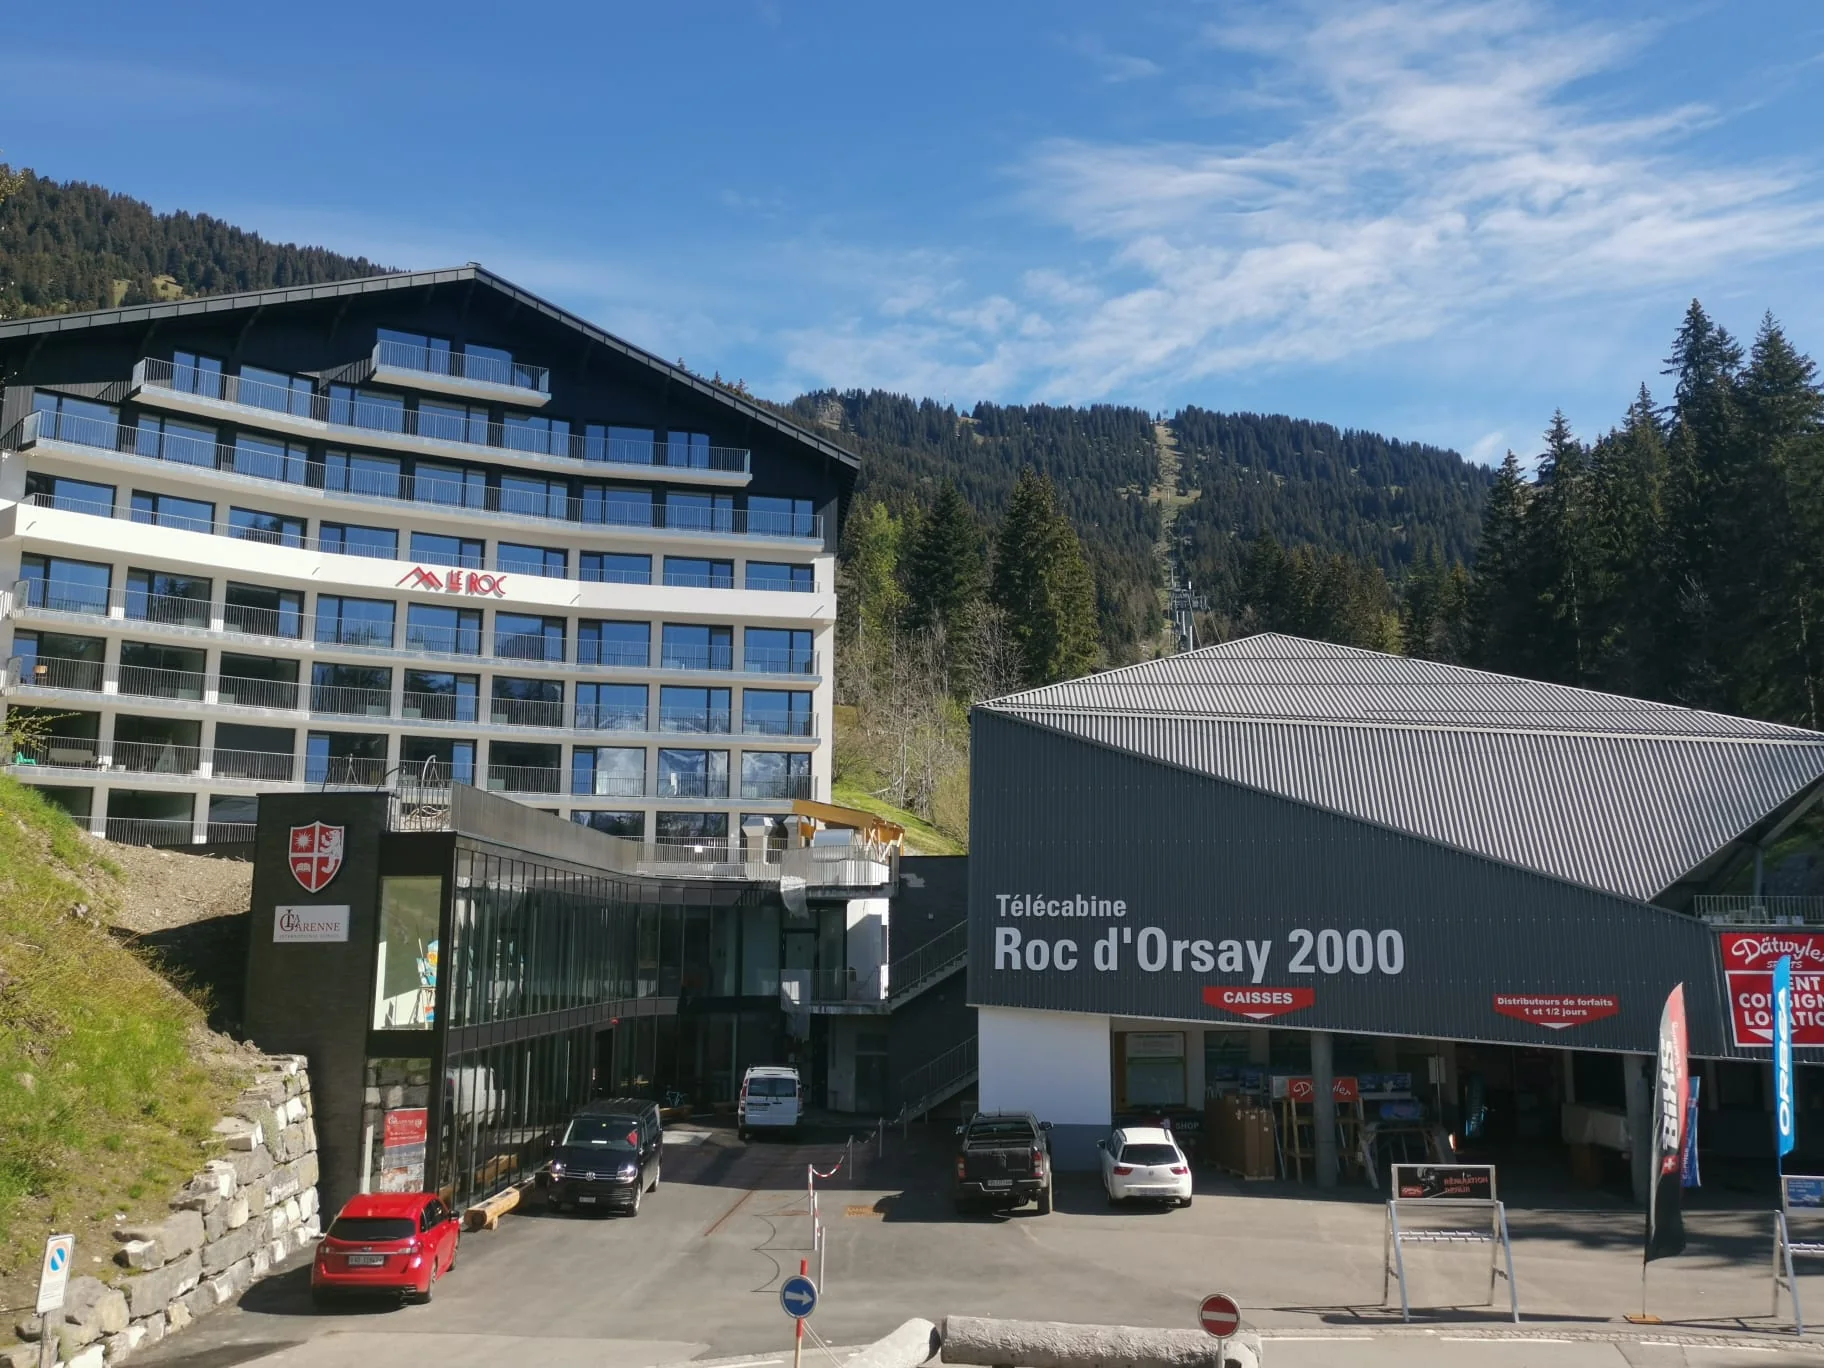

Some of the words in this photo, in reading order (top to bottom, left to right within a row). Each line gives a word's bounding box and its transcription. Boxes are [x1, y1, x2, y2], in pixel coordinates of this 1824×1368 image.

[468, 572, 508, 595] ROC
[996, 894, 1128, 917] Télécabine
[279, 913, 341, 932] GARENNE
[994, 927, 1079, 972] Roc
[1093, 926, 1272, 983] d'Orsay
[1288, 928, 1405, 974] 2000
[1223, 991, 1293, 1005] CAISSES
[1497, 997, 1560, 1006] Distributeurs
[1563, 998, 1575, 1006] de
[1577, 998, 1614, 1007] forfaits
[1524, 1007, 1529, 1016] 1
[1533, 1008, 1542, 1016] et
[1545, 1007, 1560, 1016] 1/2
[1562, 1008, 1588, 1017] jours
[1778, 987, 1791, 1136] ORBEA
[1175, 1122, 1200, 1130] SHOP
